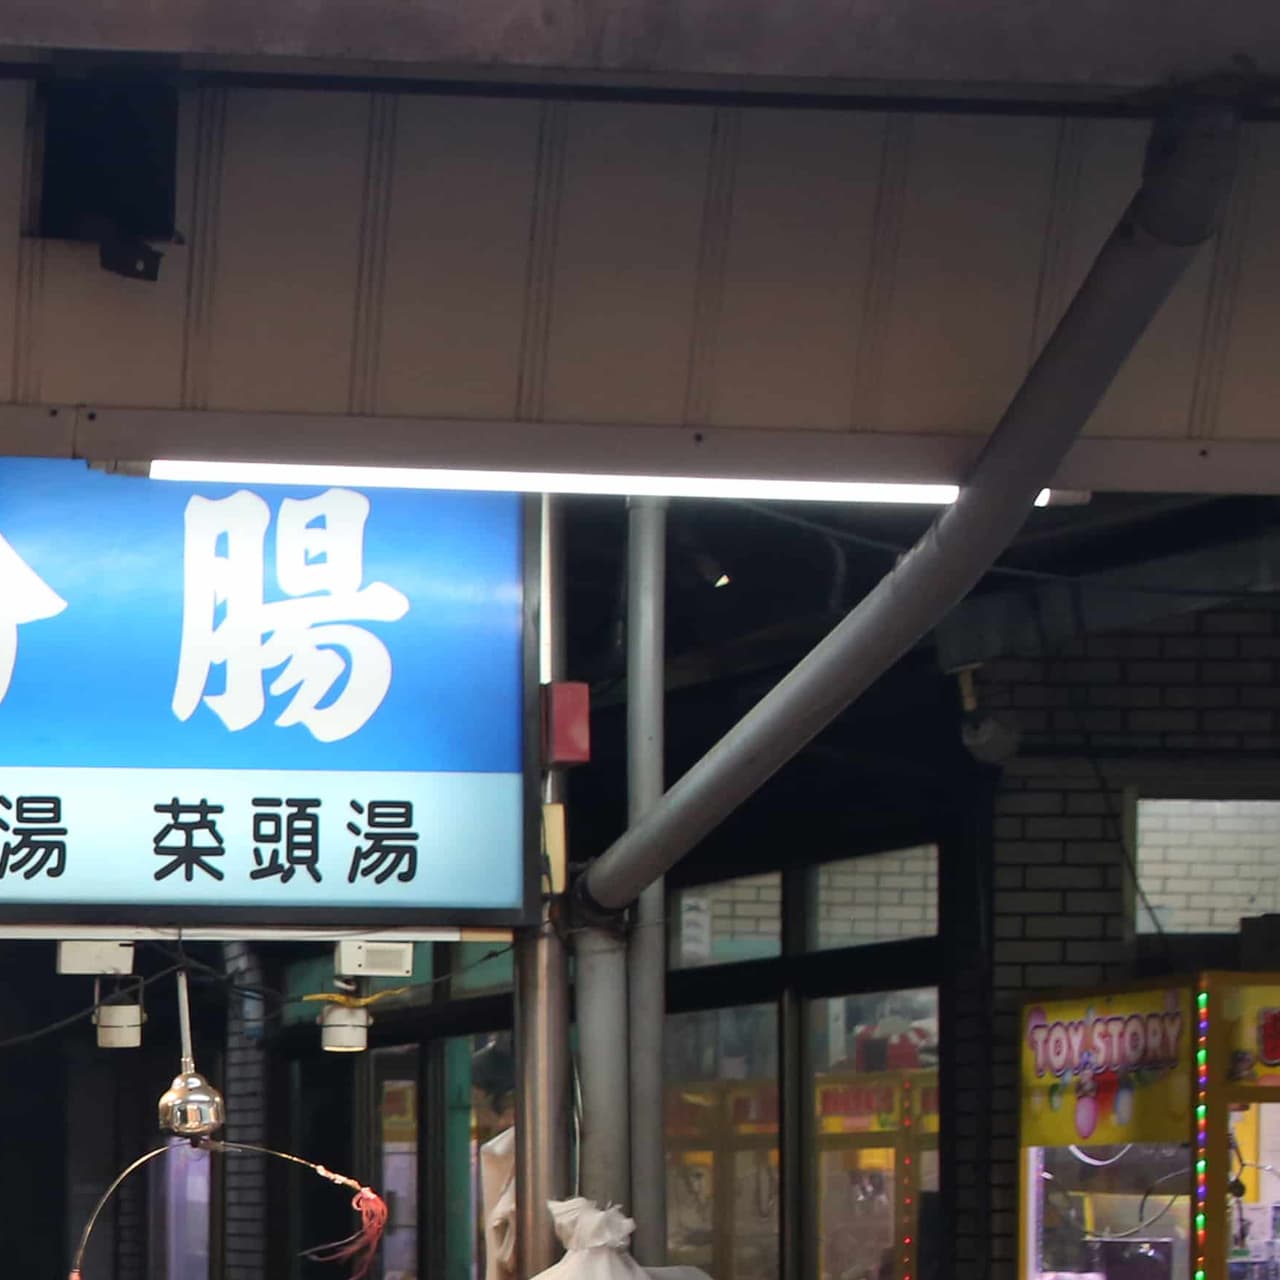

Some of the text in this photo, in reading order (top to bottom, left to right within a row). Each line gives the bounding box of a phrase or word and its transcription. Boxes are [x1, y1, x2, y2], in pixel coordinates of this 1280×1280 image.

[154, 797, 419, 884] 菜頭湯
[1031, 1012, 1183, 1078] TOY STORY
